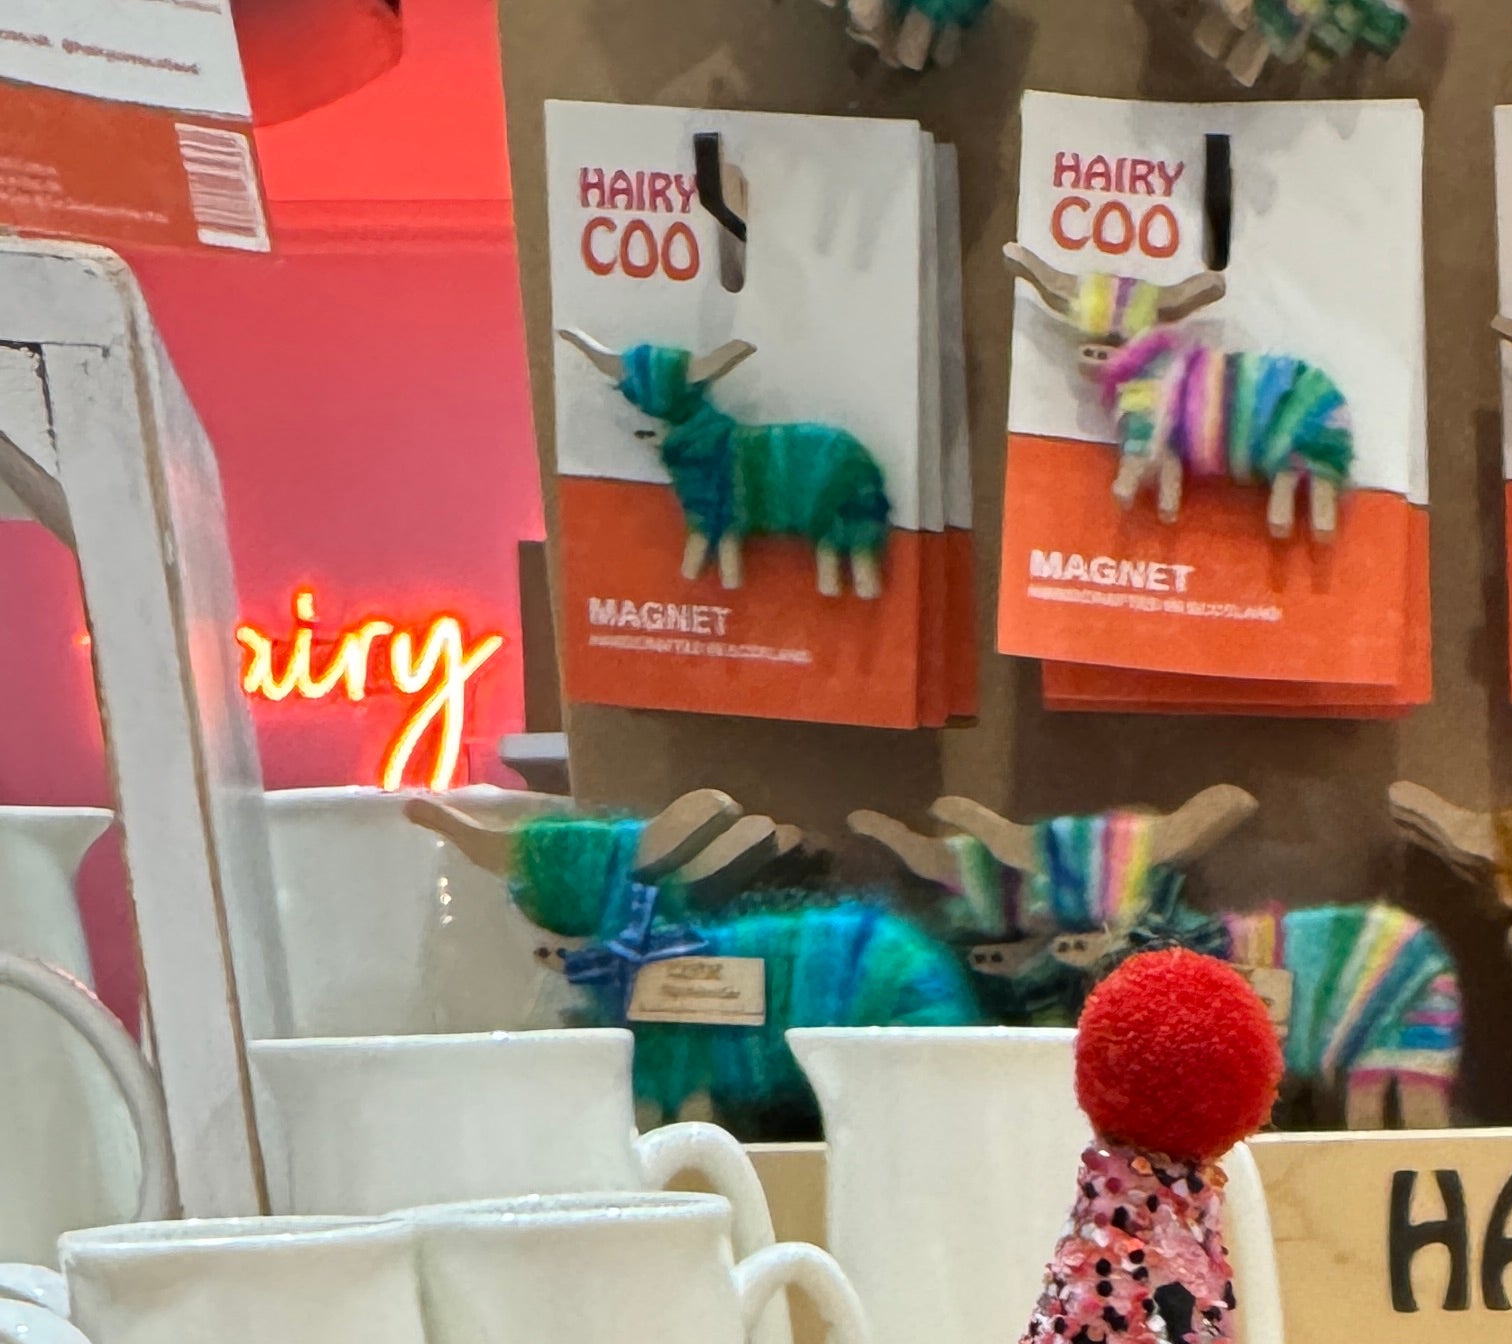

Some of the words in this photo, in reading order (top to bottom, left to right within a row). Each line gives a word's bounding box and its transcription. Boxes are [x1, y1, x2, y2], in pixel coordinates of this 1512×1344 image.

[579, 167, 697, 213] HAIRY
[1052, 151, 1185, 197] HAIRY
[581, 216, 700, 281] COO
[1050, 197, 1180, 257] COO
[1029, 549, 1195, 592] MAGNET
[588, 597, 732, 636] MAGNET
[235, 590, 503, 791] airy
